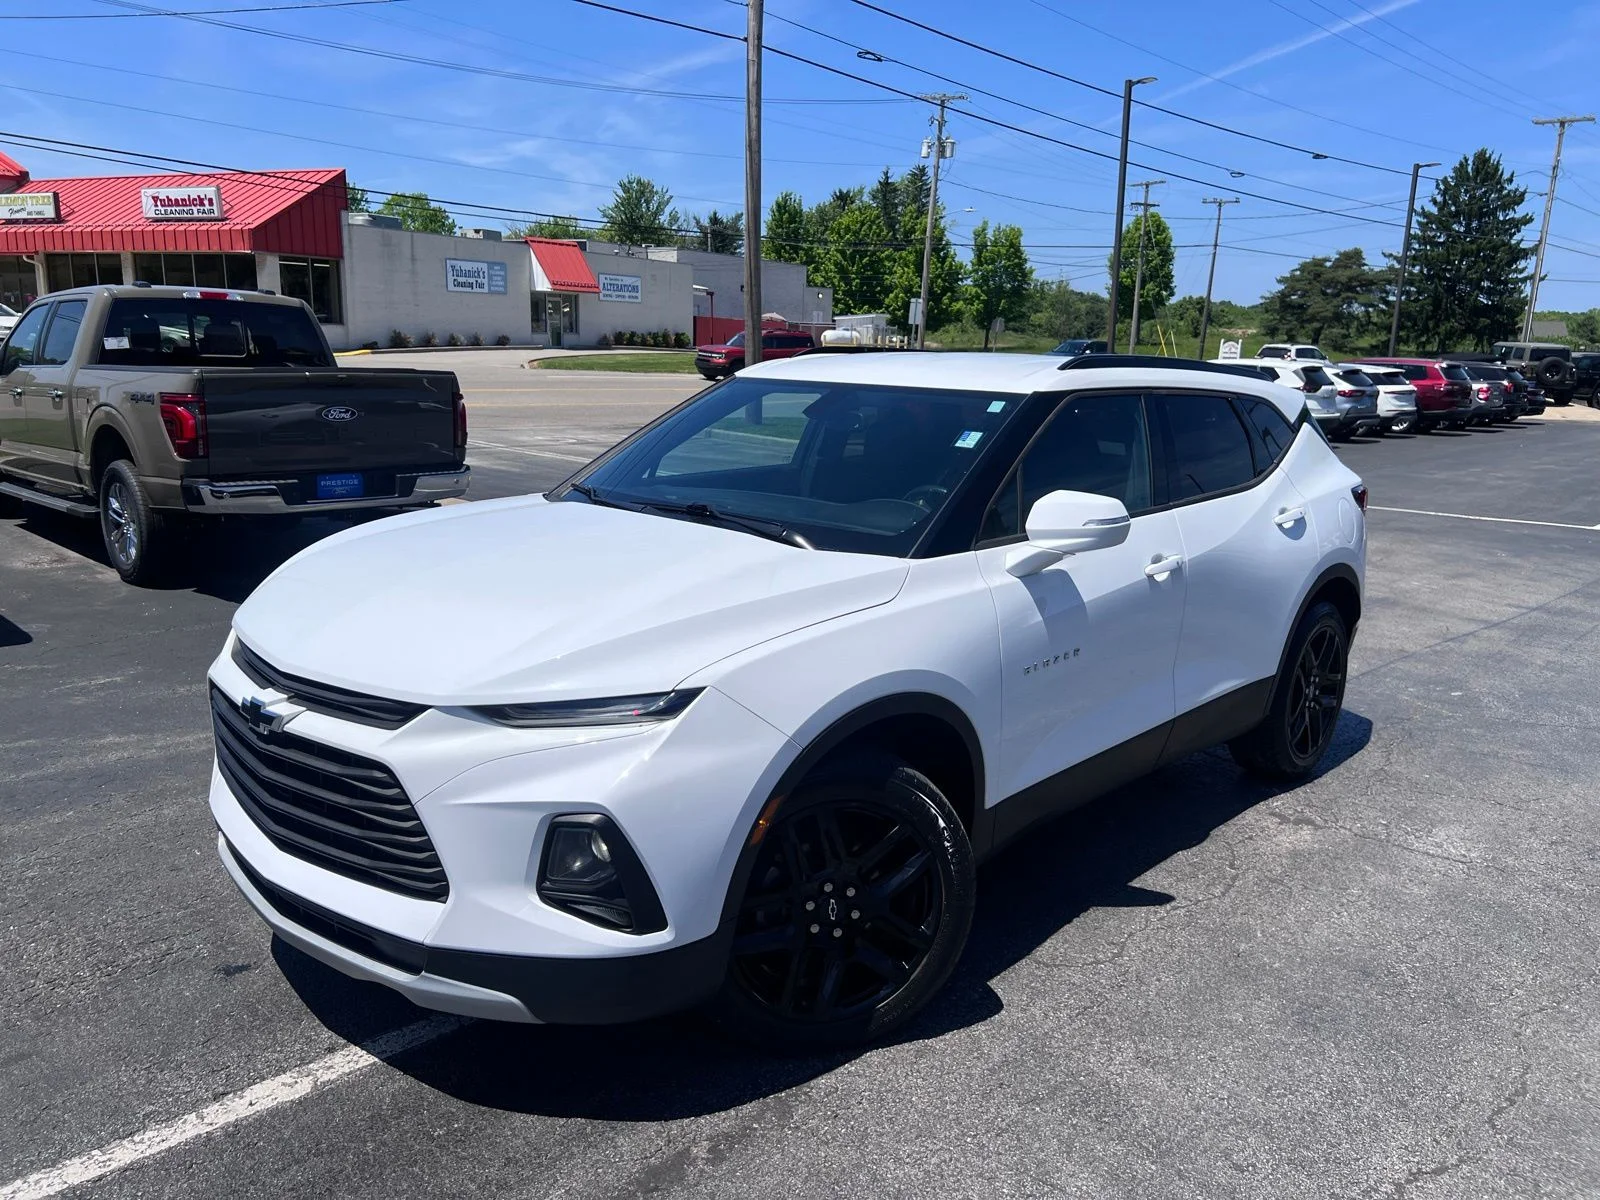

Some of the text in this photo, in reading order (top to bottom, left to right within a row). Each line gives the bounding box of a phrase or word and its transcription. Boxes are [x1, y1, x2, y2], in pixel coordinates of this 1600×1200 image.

[29, 195, 51, 205] TREE
[152, 194, 214, 207] Yuhanick's
[451, 265, 485, 279] Yuhanick's
[453, 279, 474, 290] Cleaning
[602, 282, 639, 294] ALTERATIONS
